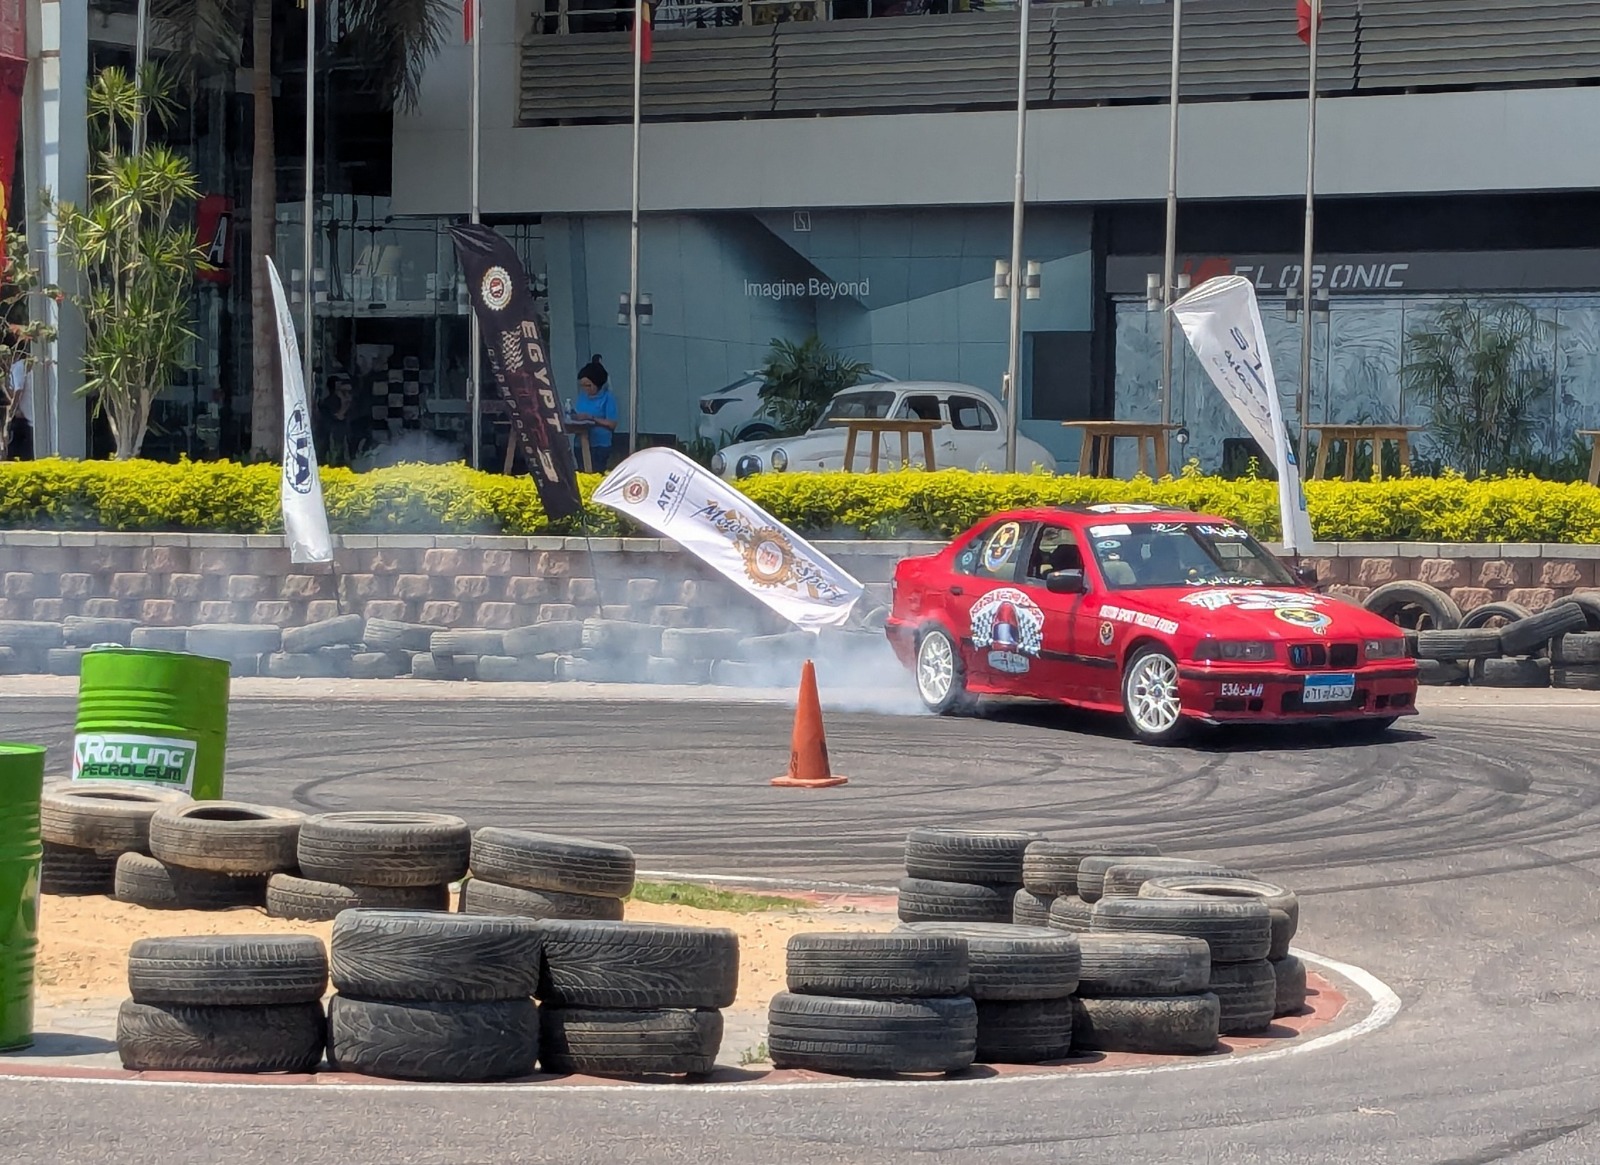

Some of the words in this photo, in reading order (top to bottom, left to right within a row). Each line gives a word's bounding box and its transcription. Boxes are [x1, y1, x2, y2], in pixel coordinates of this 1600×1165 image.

[744, 279, 806, 300] Imagine
[808, 277, 870, 300] Beyond
[521, 320, 562, 433] EGYPT
[689, 503, 750, 536] Motor
[84, 736, 186, 768] ROLLING
[81, 763, 182, 781] PETROLEUM
